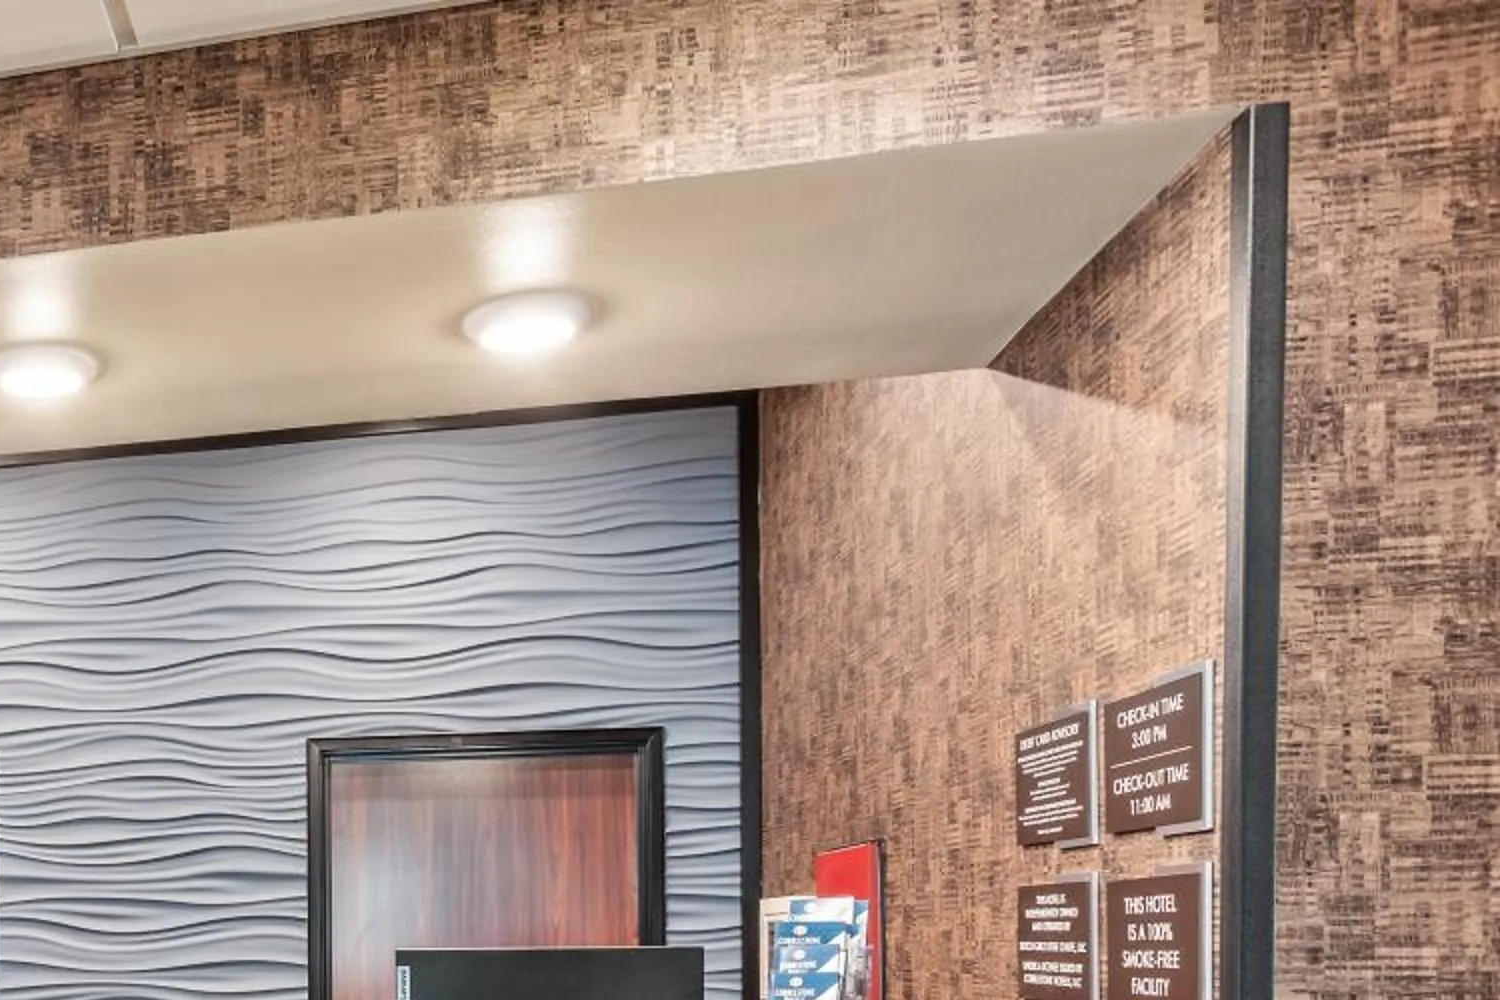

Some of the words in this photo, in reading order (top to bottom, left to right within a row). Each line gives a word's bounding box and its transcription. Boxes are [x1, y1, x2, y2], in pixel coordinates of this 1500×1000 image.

[1117, 701, 1160, 729] CHECK-IN
[1161, 693, 1185, 715] TIME
[1131, 728, 1152, 749] 3:00
[1153, 724, 1167, 743] PM
[1113, 768, 1165, 795] CHECK-OUT
[1166, 763, 1189, 784] TIME
[1129, 796, 1155, 816] 11:00
[1155, 793, 1172, 811] AM
[1123, 896, 1144, 915] THIS
[1145, 893, 1177, 913] HOTEL
[1127, 923, 1137, 941] IS
[1137, 923, 1147, 941] A
[1147, 922, 1173, 941] 100%
[1121, 949, 1181, 969] SMOKE-FREE
[1131, 977, 1171, 997] FACILITY
